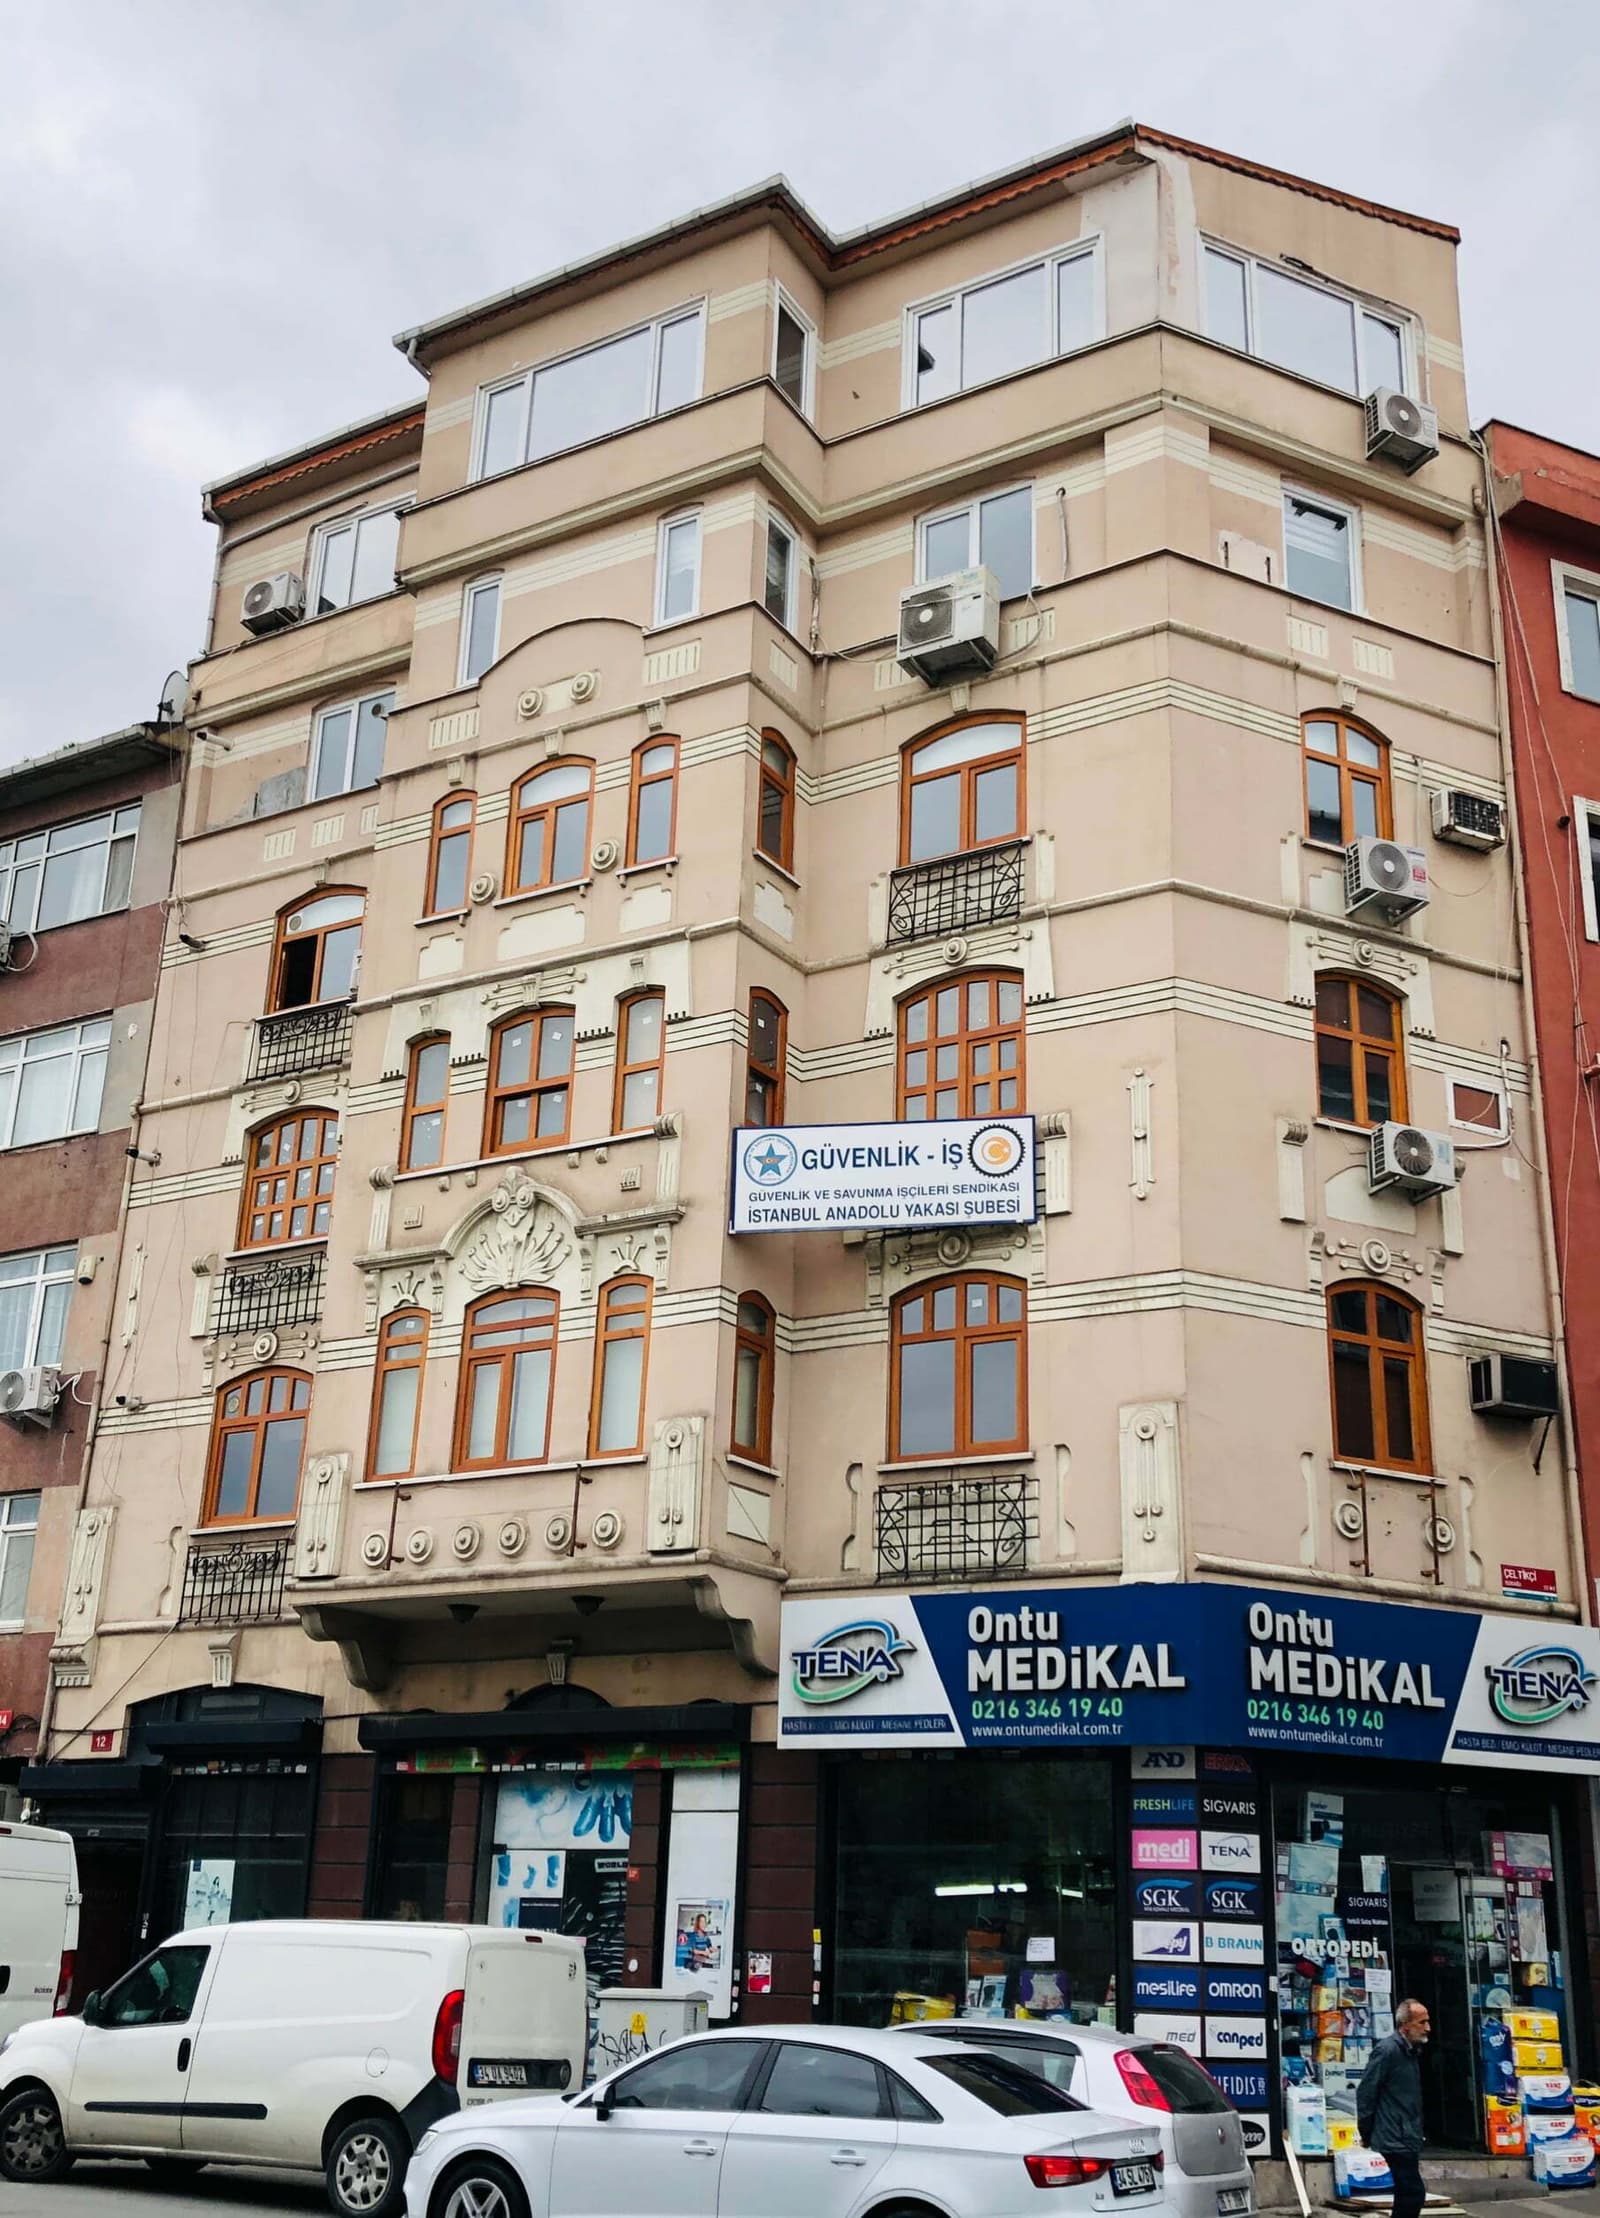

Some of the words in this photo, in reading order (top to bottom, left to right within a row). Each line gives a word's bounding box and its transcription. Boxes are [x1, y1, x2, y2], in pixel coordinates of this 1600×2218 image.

[802, 1140, 920, 1171] GÜVENLİK
[942, 1138, 963, 1170] İŞ
[749, 1187, 810, 1203] GÜVENLİK
[815, 1188, 829, 1200] VE
[833, 1186, 894, 1199] SAVUNMA
[896, 1183, 949, 1199] İŞÇİLERİ
[953, 1181, 1020, 1195] SENDİKASI
[748, 1205, 821, 1224] İSTANBUL
[826, 1204, 900, 1220] ANADOLU
[905, 1201, 959, 1217] YAKASI
[963, 1195, 1021, 1219] ŞUBESİ
[968, 1605, 1058, 1643] Ontu
[1250, 1602, 1333, 1647] Ontu
[1491, 1666, 1591, 1703] TENA
[972, 1699, 1021, 1720] 0216
[1026, 1698, 1061, 1719] 346
[1069, 1698, 1089, 1719] 19
[1099, 1697, 1123, 1718] 40
[1248, 1699, 1292, 1722] 0216
[1298, 1703, 1330, 1725] 346
[1337, 1707, 1357, 1728] 19
[1363, 1709, 1384, 1730] 40
[972, 1722, 1124, 1738] www.ontumedikal.com.tr
[1248, 1726, 1384, 1748] www.ontumedikal.com.tr
[95, 1735, 106, 1748] 12
[1203, 1798, 1256, 1815] SIGVARIS
[1138, 1837, 1191, 1859] medi
[1208, 1844, 1252, 1858] TENA
[1142, 1888, 1181, 1907] SGK
[1211, 1890, 1247, 1909] SGK
[1348, 1896, 1388, 1908] SIGVARIS
[1217, 1936, 1263, 1950] BRAUN
[1291, 1937, 1379, 1959] ORTOPEDİ
[1216, 2029, 1264, 2050] canped
